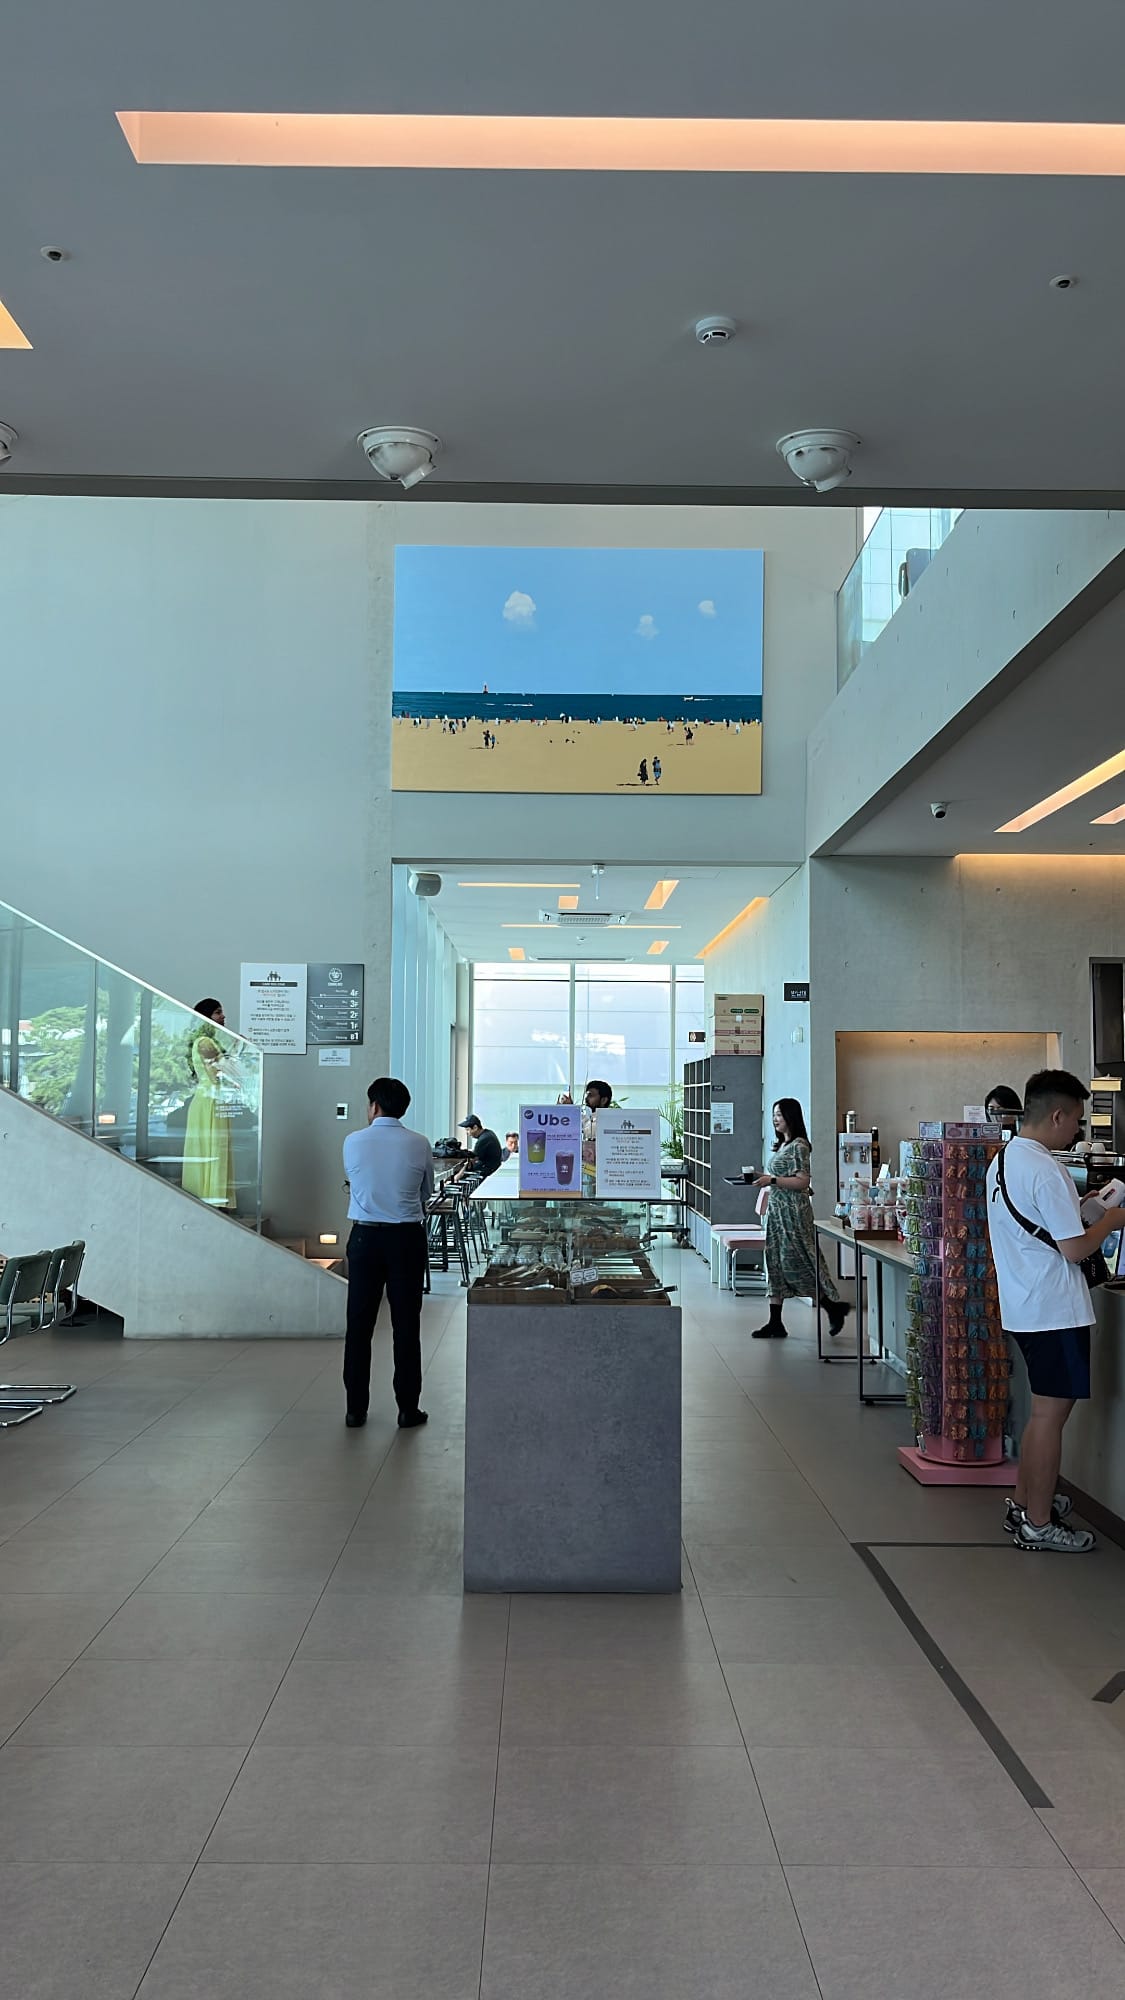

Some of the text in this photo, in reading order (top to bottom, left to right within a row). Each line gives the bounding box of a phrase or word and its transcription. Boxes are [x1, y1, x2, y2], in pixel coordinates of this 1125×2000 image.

[350, 1022, 359, 1030] 1F
[350, 1032, 359, 1040] B1
[537, 1114, 570, 1126] Ube
